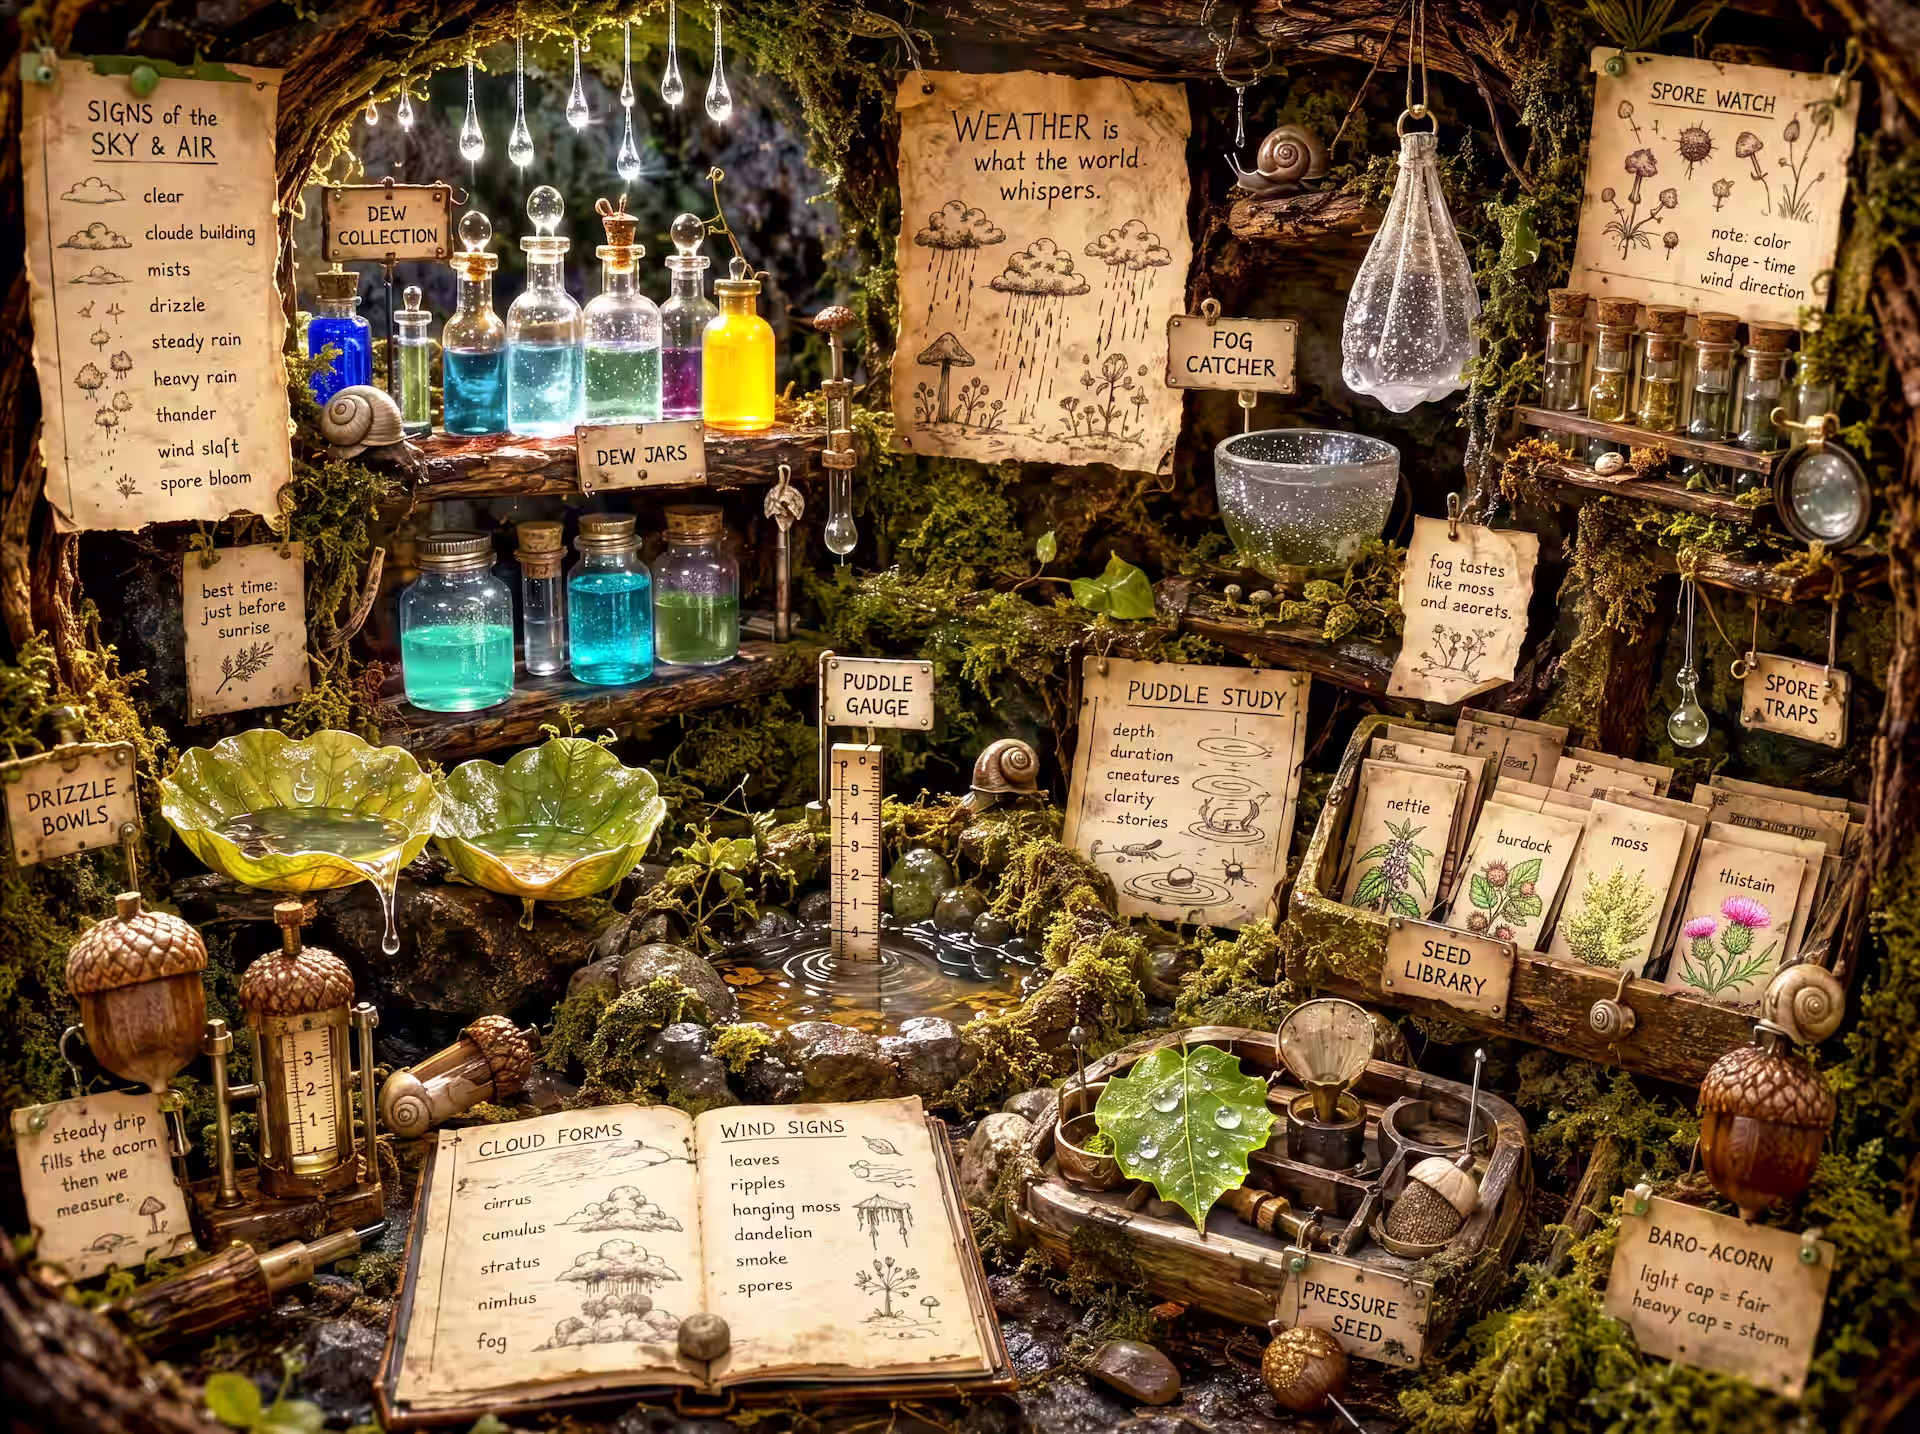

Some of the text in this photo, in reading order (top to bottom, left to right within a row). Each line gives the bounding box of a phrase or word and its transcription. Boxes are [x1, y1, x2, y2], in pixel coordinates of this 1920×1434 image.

[1651, 81, 1777, 113] SPORE WATCH
[88, 100, 218, 127] SIGNS of the
[950, 109, 1119, 143] WEATHER is
[91, 131, 216, 159] SKY & AIR
[974, 149, 1026, 172] what
[1035, 148, 1068, 171] the
[143, 186, 184, 203] clear
[999, 178, 1101, 211] whispers.
[367, 205, 407, 223] DEW
[145, 223, 256, 246] cloude building
[338, 228, 438, 246] COLLECTION
[1711, 227, 1792, 250] note: color
[148, 261, 191, 277] mists
[1706, 247, 1749, 272] shape
[1763, 256, 1796, 275] time
[1700, 272, 1805, 301] wind direction
[149, 296, 206, 313] drizzle
[152, 332, 242, 354] steady rain
[1213, 331, 1253, 353] FOG
[1186, 355, 1277, 377] CATCHER
[154, 370, 237, 392] heavy rain
[155, 405, 217, 423] thander
[157, 439, 195, 459] wind
[596, 444, 688, 467] DEW JARS
[160, 468, 252, 497] spore bloom
[1430, 553, 1505, 578] fog tastes
[202, 579, 278, 599] best time:
[1427, 571, 1494, 597] like moss
[201, 597, 286, 626] just before
[1420, 594, 1448, 610] and
[218, 623, 271, 639] sunrise
[843, 672, 913, 692] PUDDLE
[1765, 674, 1819, 701] SPORE
[1128, 680, 1287, 711] PUDDLE STUDY
[846, 697, 909, 718] GAUGE
[1765, 697, 1818, 724] TRAPS
[1112, 722, 1154, 742] depth
[1110, 743, 1173, 763] duration
[26, 777, 117, 815] DRIZZLE
[850, 784, 859, 797] 5
[1104, 787, 1155, 811] clarity
[41, 805, 109, 836] BOWLS
[851, 811, 859, 825] 4
[1117, 812, 1168, 829] stories
[851, 840, 859, 853] 3
[1496, 829, 1553, 855] burdock
[1611, 836, 1649, 852] moss
[850, 868, 860, 881] 2
[1719, 868, 1775, 894] thistain
[1421, 940, 1471, 965] SEED
[1404, 960, 1487, 996] LIBRARY
[303, 1051, 313, 1066] 3
[305, 1081, 316, 1097] 2
[53, 1112, 147, 1144] steady drip
[720, 1119, 845, 1139] WIND SIGNS
[79, 1147, 106, 1164] the
[112, 1138, 157, 1156] acorn
[478, 1123, 623, 1157] CLOUD FORMS
[729, 1154, 780, 1167] leaves
[61, 1168, 128, 1193] then we
[731, 1175, 786, 1196] ripples
[56, 1192, 130, 1218] measure.
[732, 1203, 841, 1221] hanging moss
[482, 1221, 546, 1242] cumulus
[734, 1225, 812, 1241] dandelion
[480, 1257, 540, 1275] stratus
[736, 1251, 788, 1267] smoke
[738, 1281, 793, 1298] spores
[1640, 1264, 1679, 1292] light
[1684, 1282, 1715, 1305] cap
[1737, 1290, 1771, 1313] fair
[1303, 1281, 1399, 1320] PRESSURE
[1331, 1315, 1383, 1342] SEED
[1632, 1289, 1681, 1324] heavy
[1687, 1311, 1717, 1334] cap
[1738, 1321, 1790, 1349] storm
[476, 1332, 507, 1354] fog
